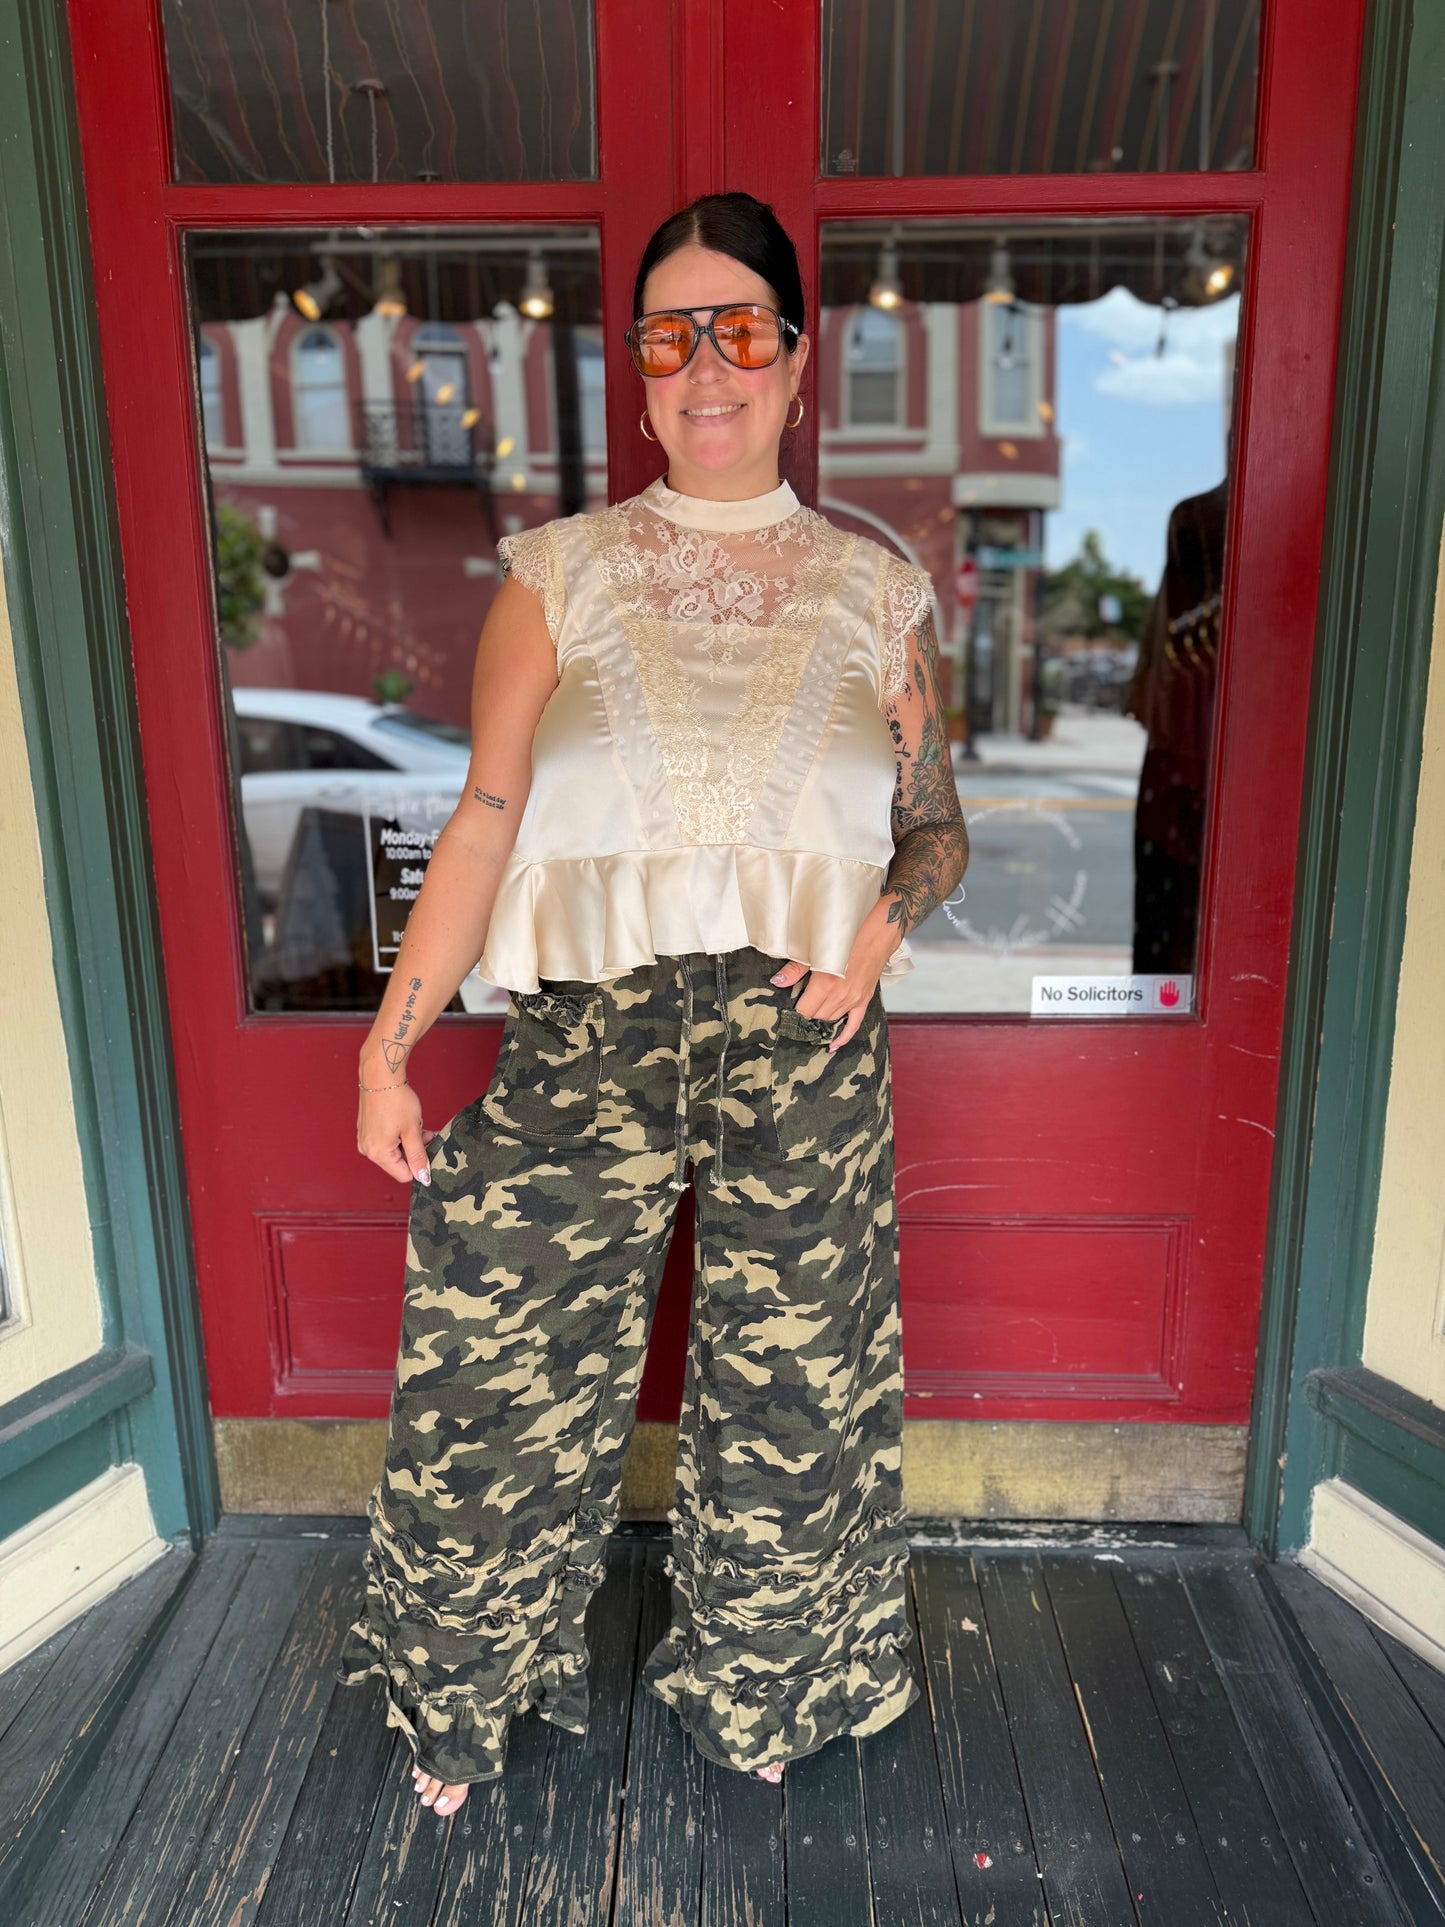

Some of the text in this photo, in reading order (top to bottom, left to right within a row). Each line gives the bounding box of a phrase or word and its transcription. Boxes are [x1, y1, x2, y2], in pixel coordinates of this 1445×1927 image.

[380, 828, 440, 848] Monday-F
[385, 847, 432, 860] 10:00am to
[1041, 986, 1143, 1001] No Solicitors
